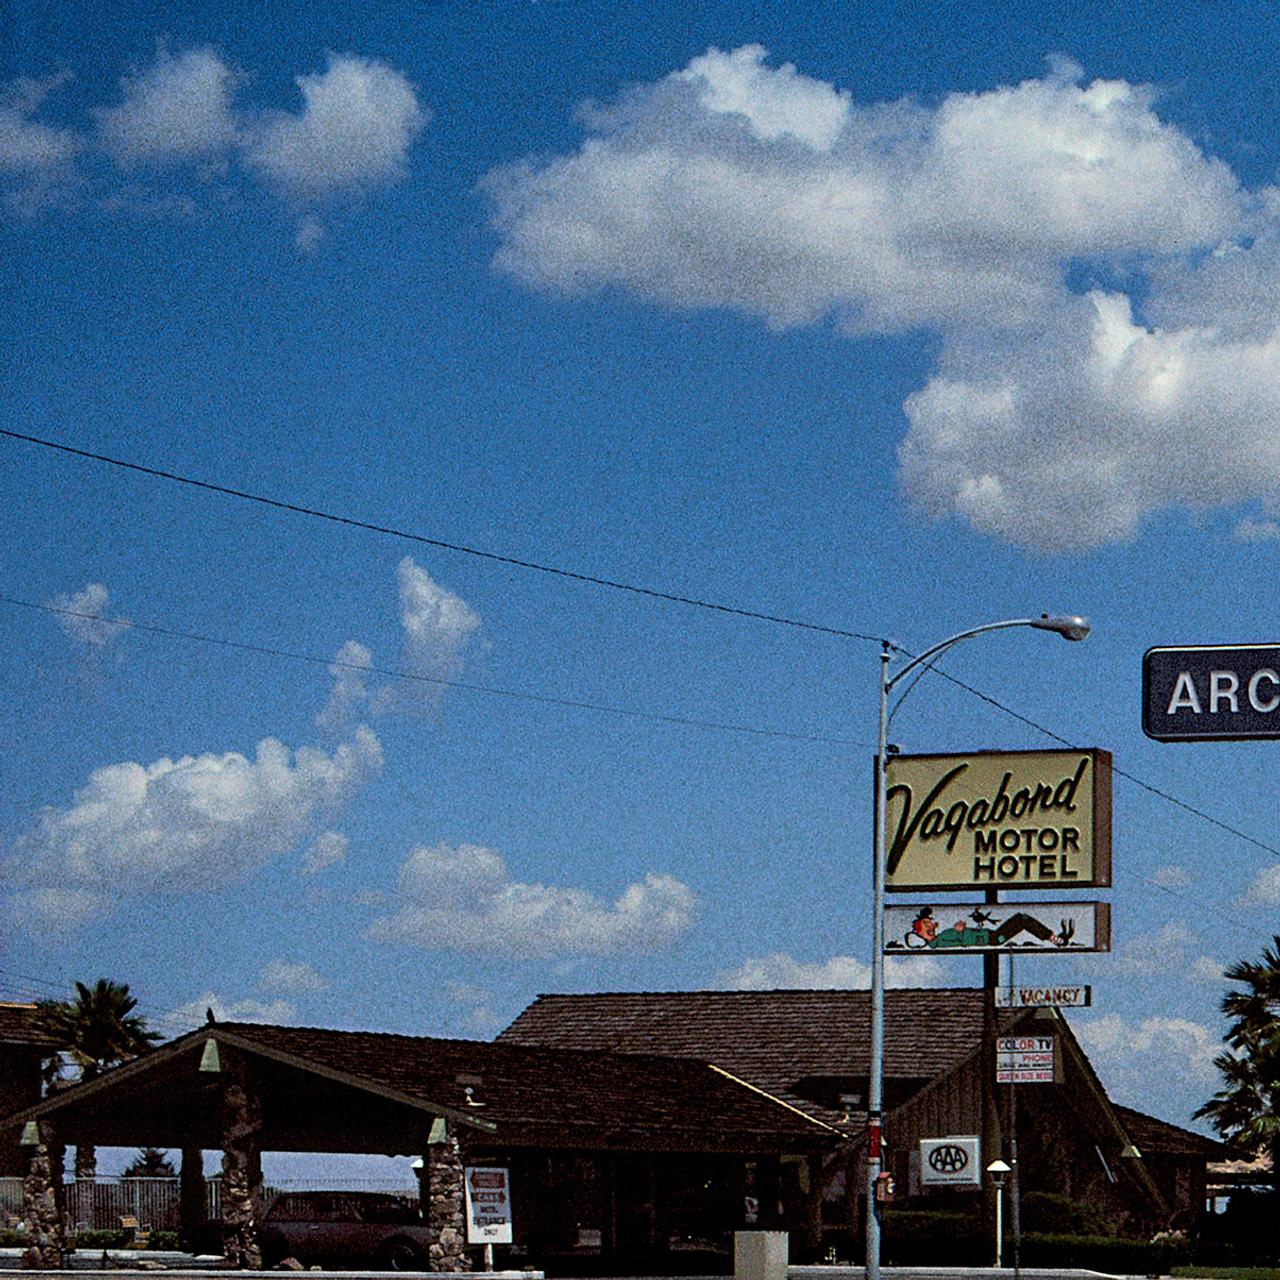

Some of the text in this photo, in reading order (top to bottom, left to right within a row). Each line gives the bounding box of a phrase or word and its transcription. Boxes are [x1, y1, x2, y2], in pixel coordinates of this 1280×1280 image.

[886, 756, 1090, 876] Vagabond
[974, 827, 1080, 852] MOTOR
[973, 854, 1079, 881] HOTEL
[1020, 987, 1080, 1005] VACANCY
[996, 1039, 1052, 1051] COLOR TV
[930, 1146, 968, 1172] AAA
